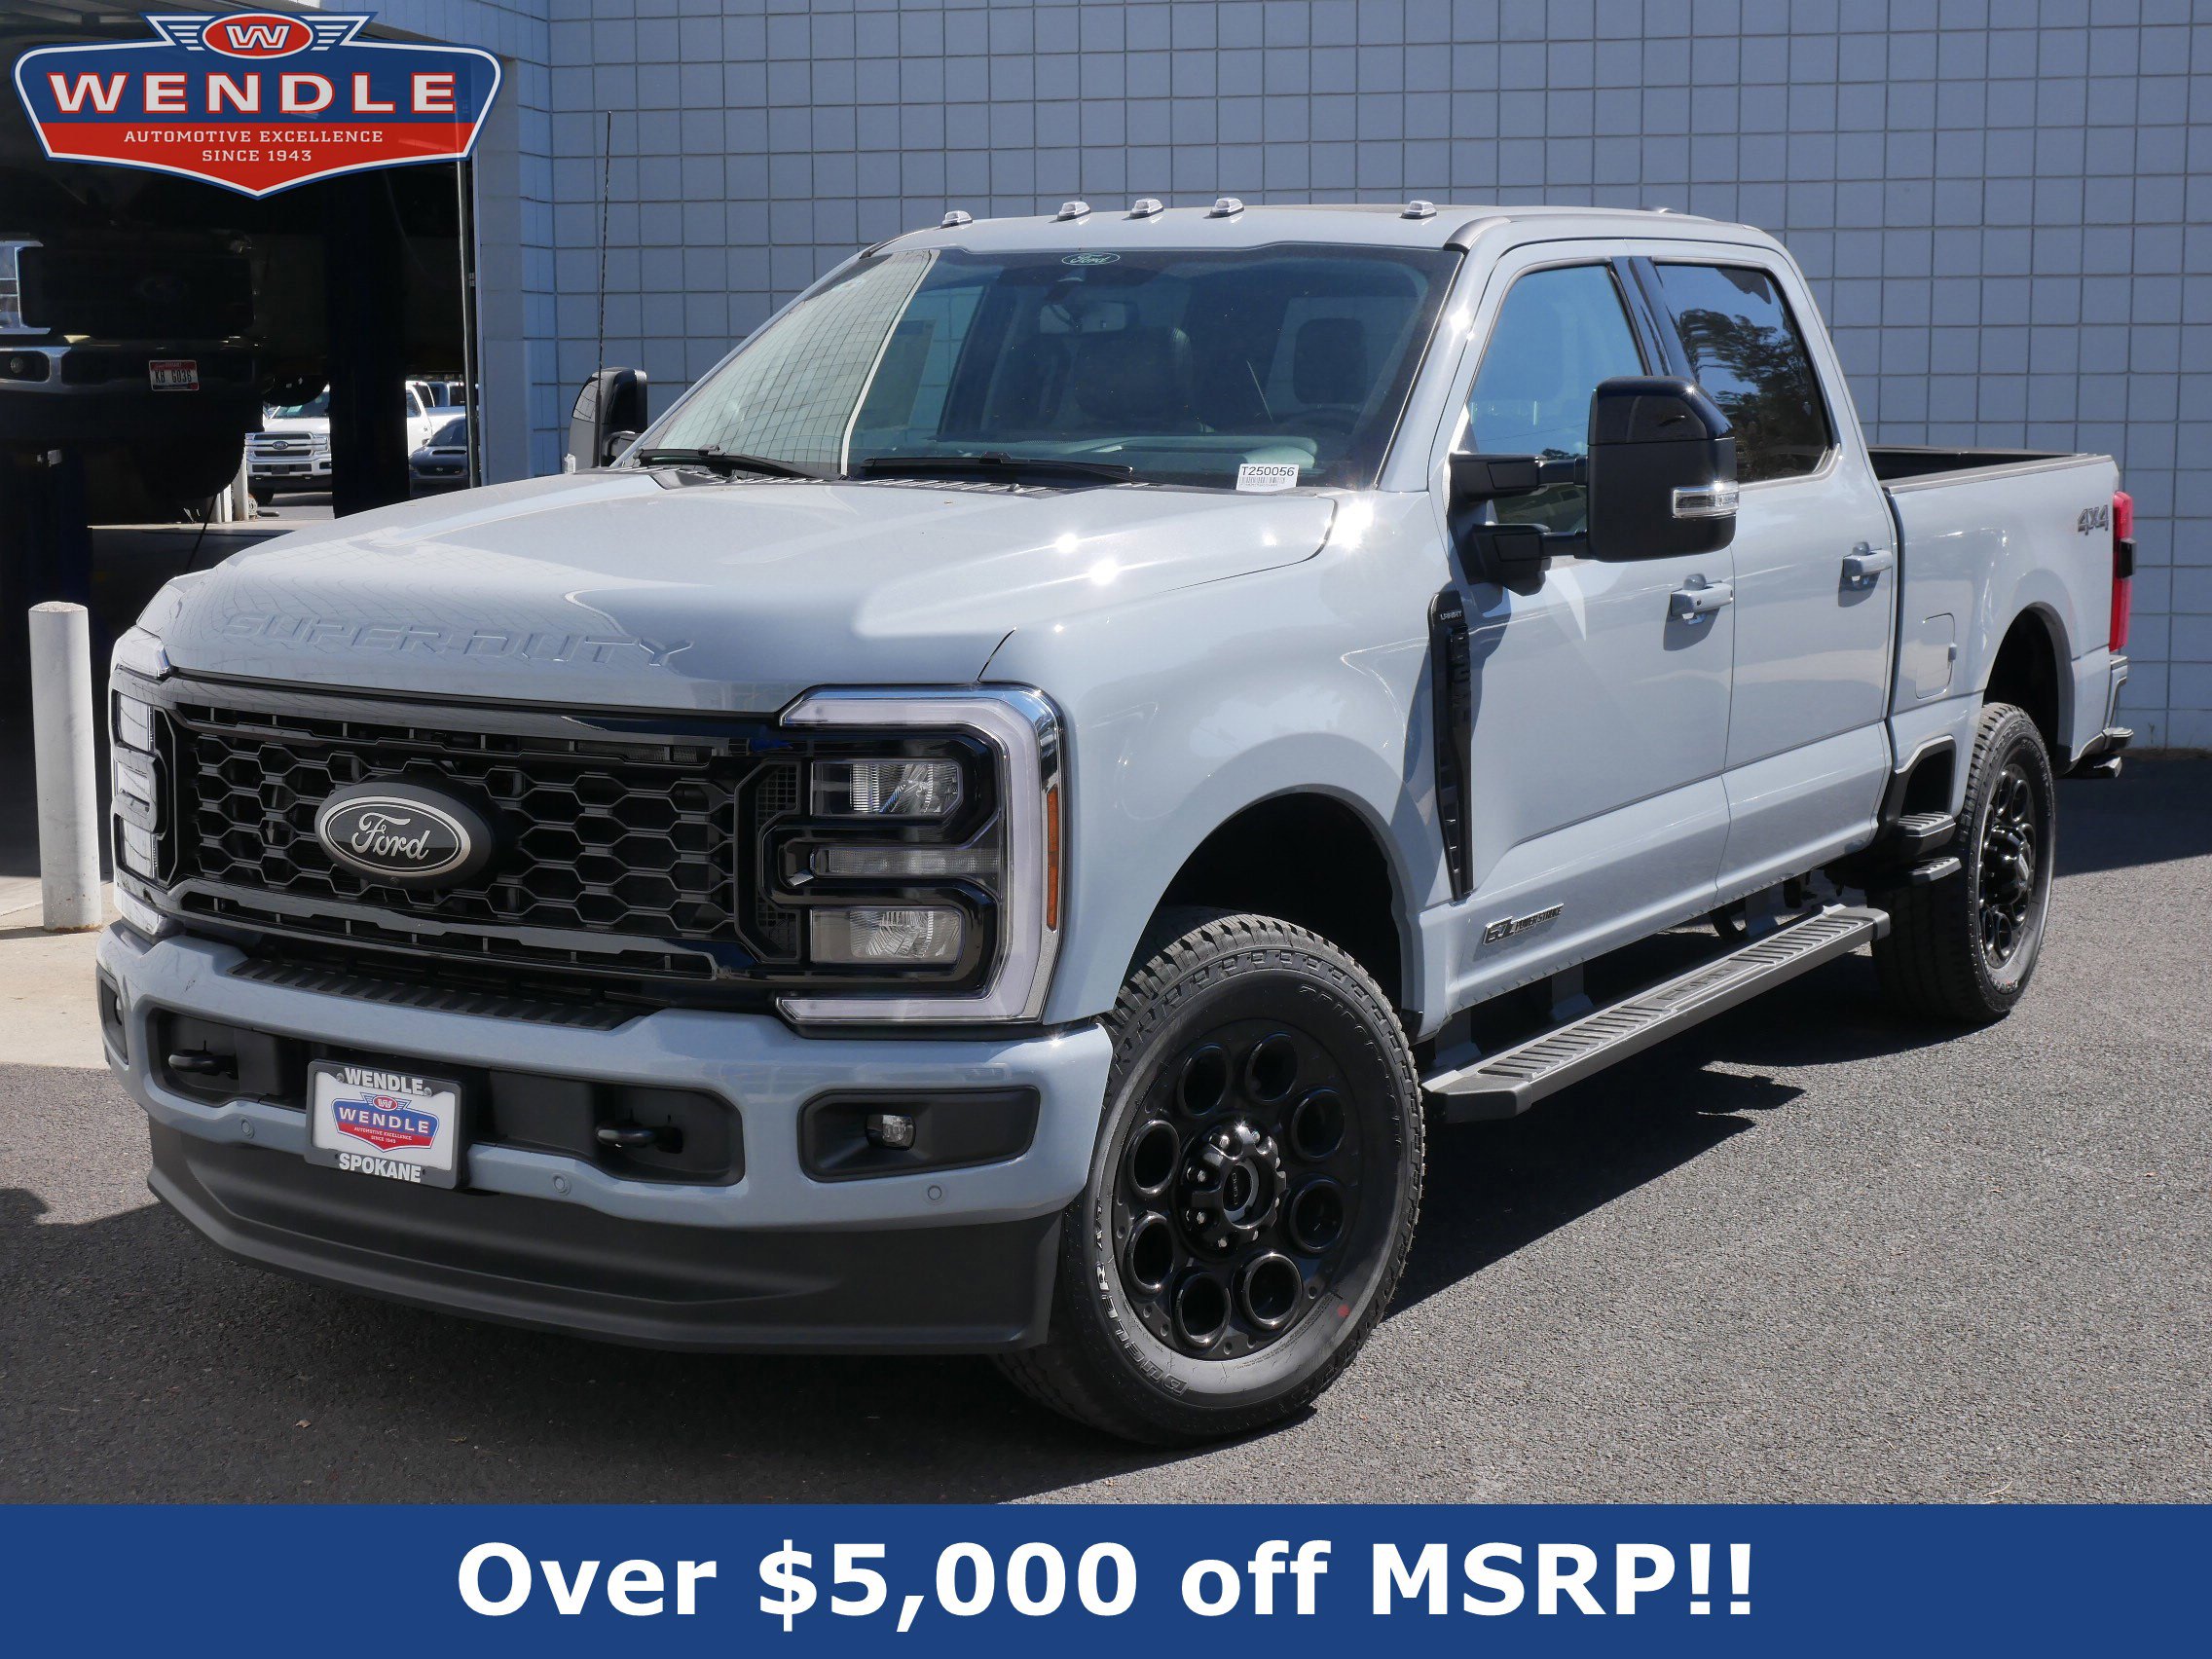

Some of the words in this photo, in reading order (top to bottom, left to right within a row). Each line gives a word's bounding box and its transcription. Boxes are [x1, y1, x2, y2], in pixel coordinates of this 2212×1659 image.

[1241, 466, 1296, 477] T250056
[222, 612, 442, 653] SUPER
[461, 632, 695, 667] DUTY
[351, 812, 431, 861] Ford
[344, 1067, 424, 1096] WENDLE
[339, 1107, 429, 1134] WENDLE
[354, 1126, 383, 1136] AUTOMOTIVE
[384, 1131, 412, 1140] EXCELLENCE
[339, 1153, 422, 1183] SPOKANE
[1096, 1262, 1188, 1396] DUELER
